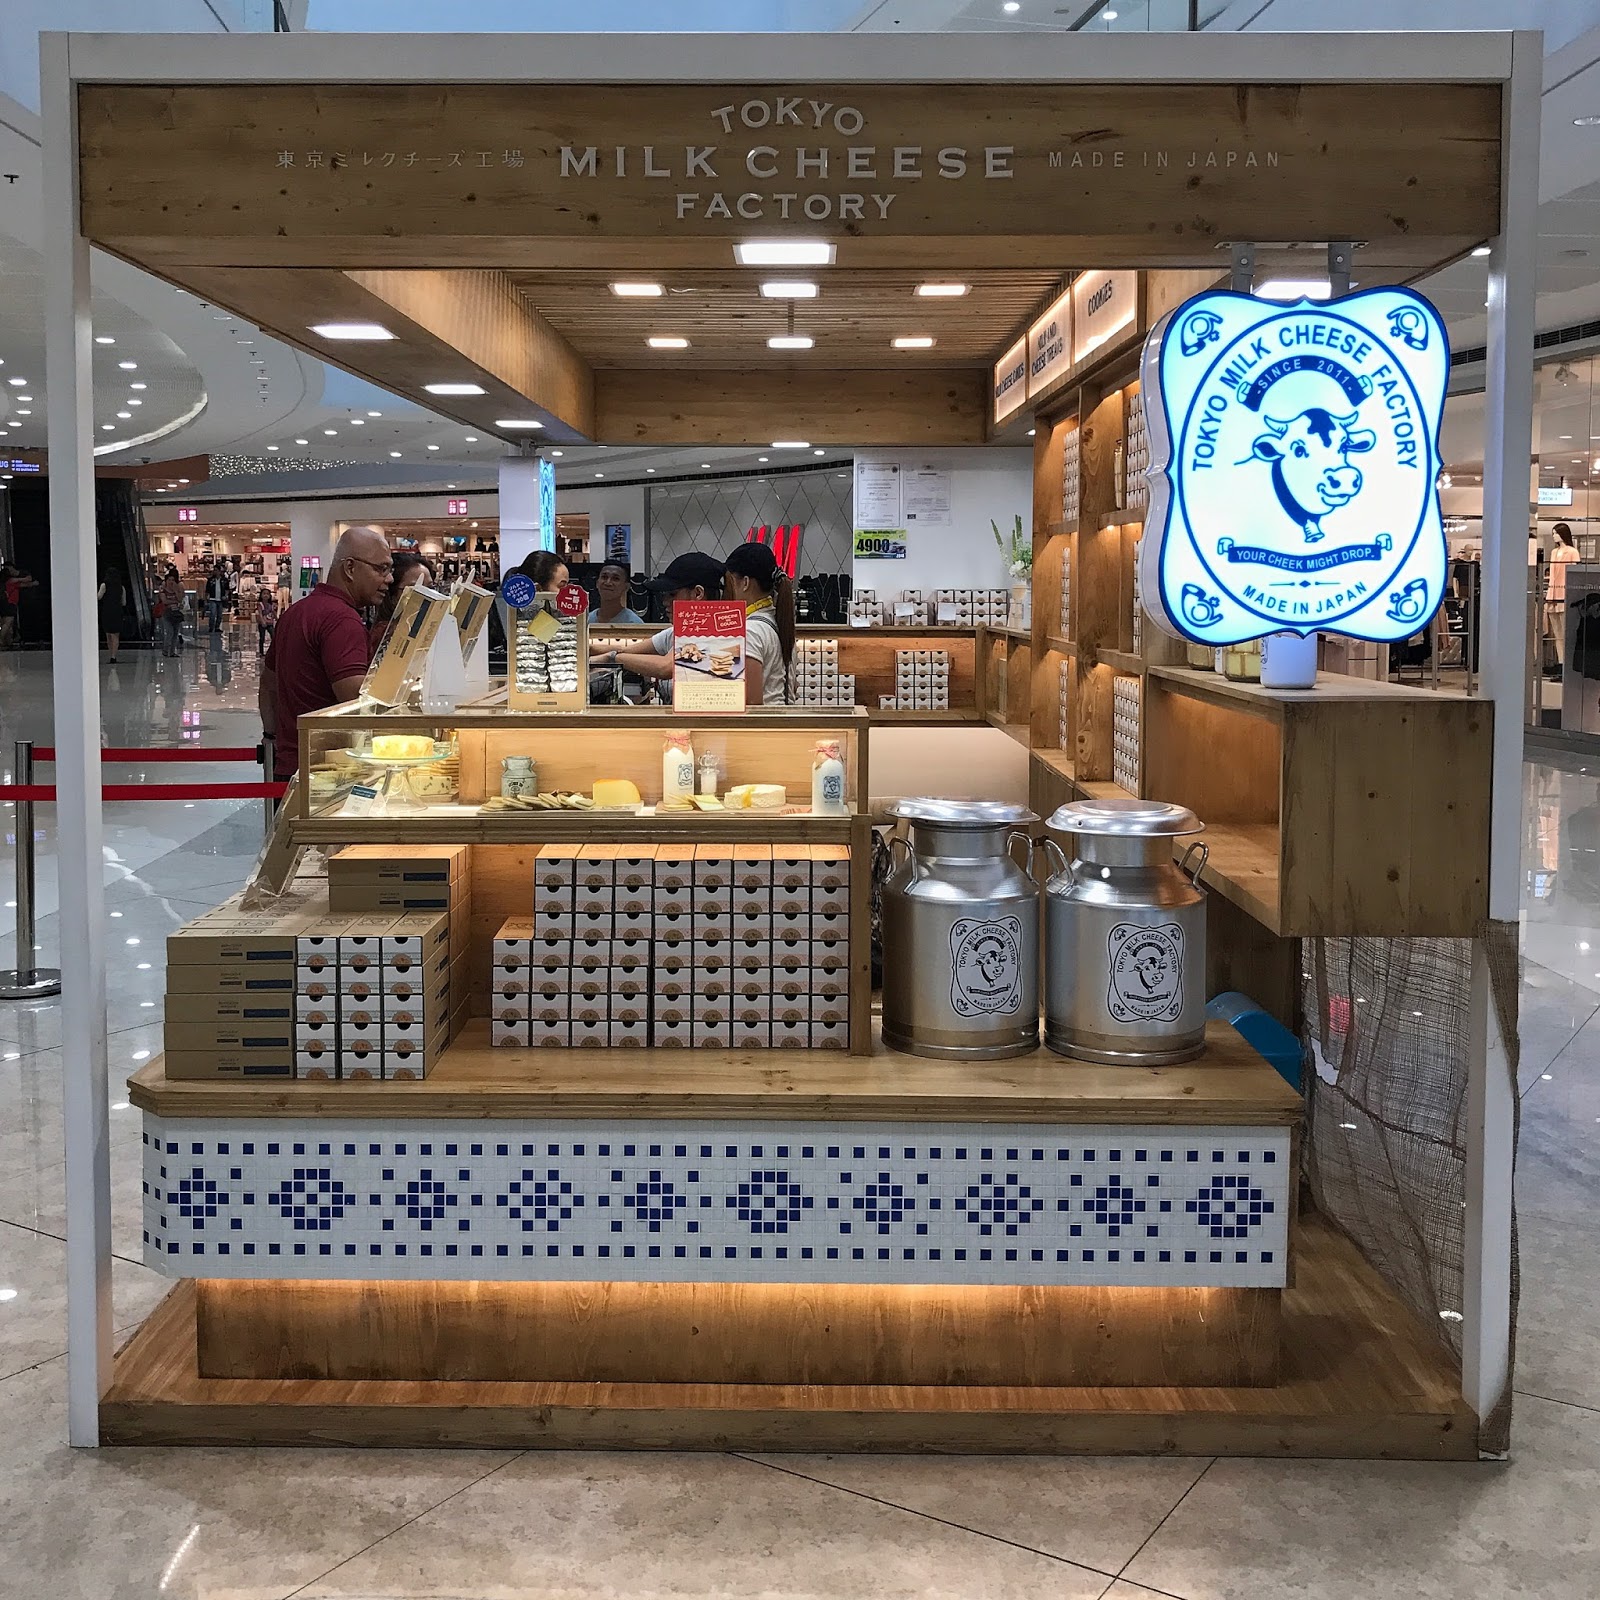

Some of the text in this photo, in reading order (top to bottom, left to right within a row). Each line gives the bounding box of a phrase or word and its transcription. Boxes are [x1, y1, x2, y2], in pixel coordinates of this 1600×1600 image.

[710, 97, 864, 136] TOKYO
[559, 145, 1014, 179] MILK CHEESE
[1049, 151, 1279, 168] MADE IN JAPAN
[676, 192, 897, 220] FACTORY
[1088, 279, 1113, 317] COOKIES
[1192, 324, 1418, 471] TOKYO MILK CHEESE FACTORY
[856, 538, 890, 553] 4900
[1237, 550, 1266, 562] YOUR
[1268, 554, 1303, 569] CHEEK
[1306, 553, 1340, 569] MIGHT
[1243, 581, 1368, 614] MADE IN JAPAN
[959, 946, 969, 968] TOKYO
[966, 931, 981, 946] MILK
[982, 927, 1006, 938] CHEESE
[1005, 937, 1017, 965] FACTORY
[1117, 951, 1128, 973] TOKYO
[1125, 936, 1140, 951] MILK
[1141, 933, 1167, 945] CHEESE
[1166, 944, 1177, 974] FACTORY
